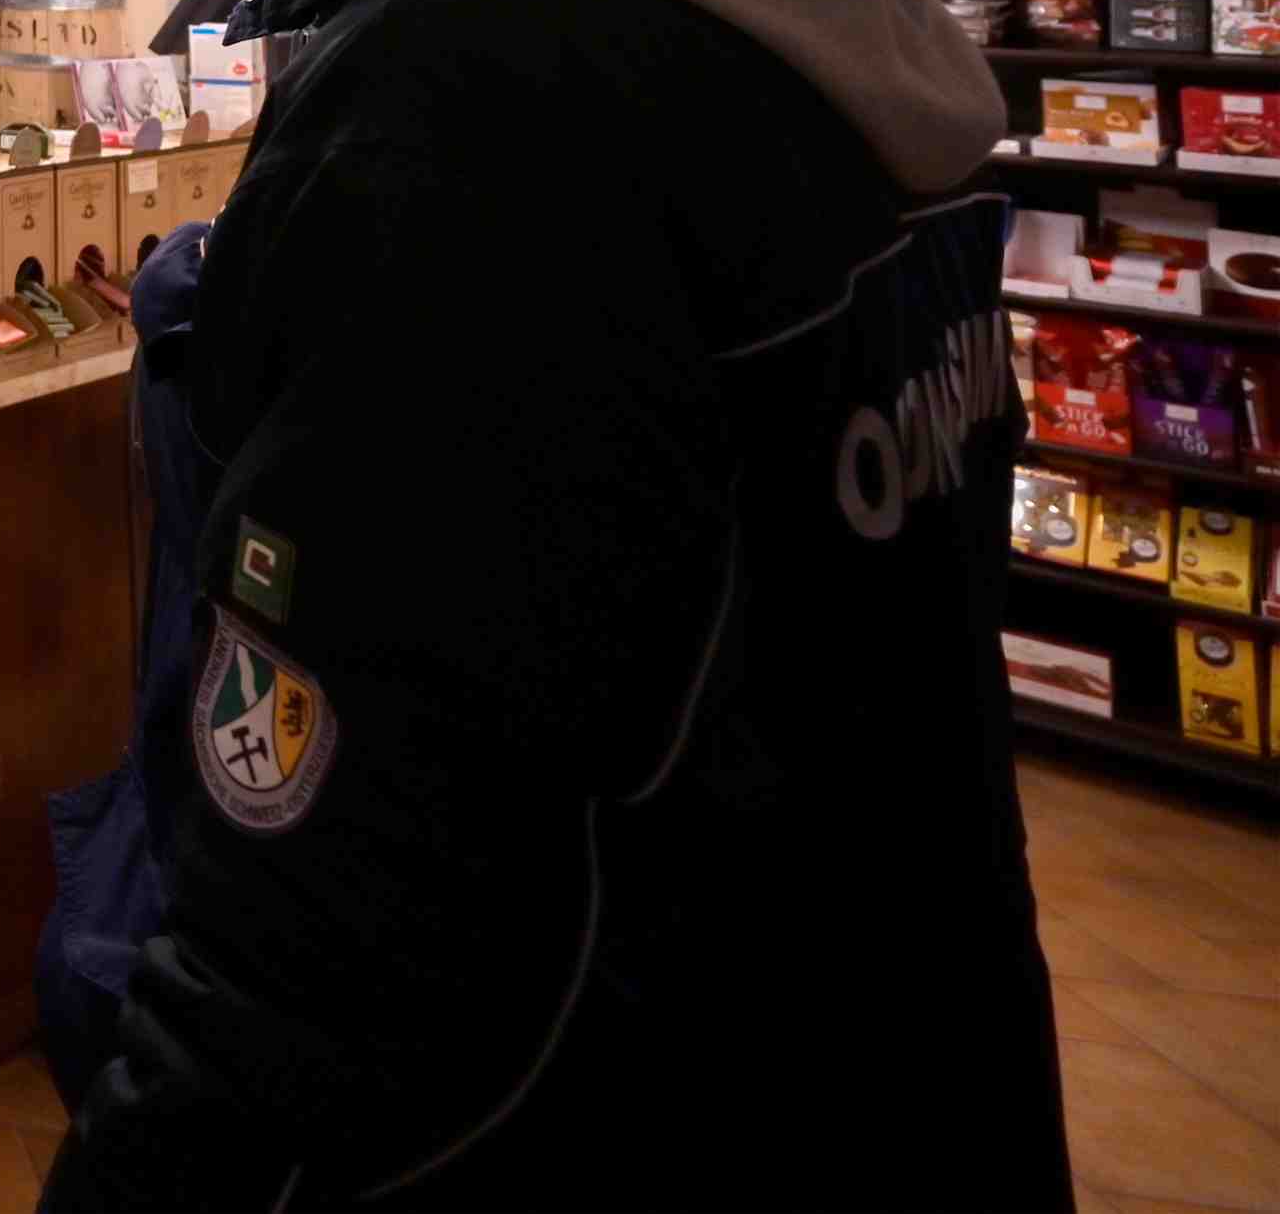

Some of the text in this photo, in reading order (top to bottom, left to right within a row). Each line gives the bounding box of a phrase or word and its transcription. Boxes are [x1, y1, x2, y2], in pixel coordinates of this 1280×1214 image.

[1054, 403, 1105, 426] STICK
[1080, 421, 1108, 440] GO
[1153, 419, 1204, 440] STICK
